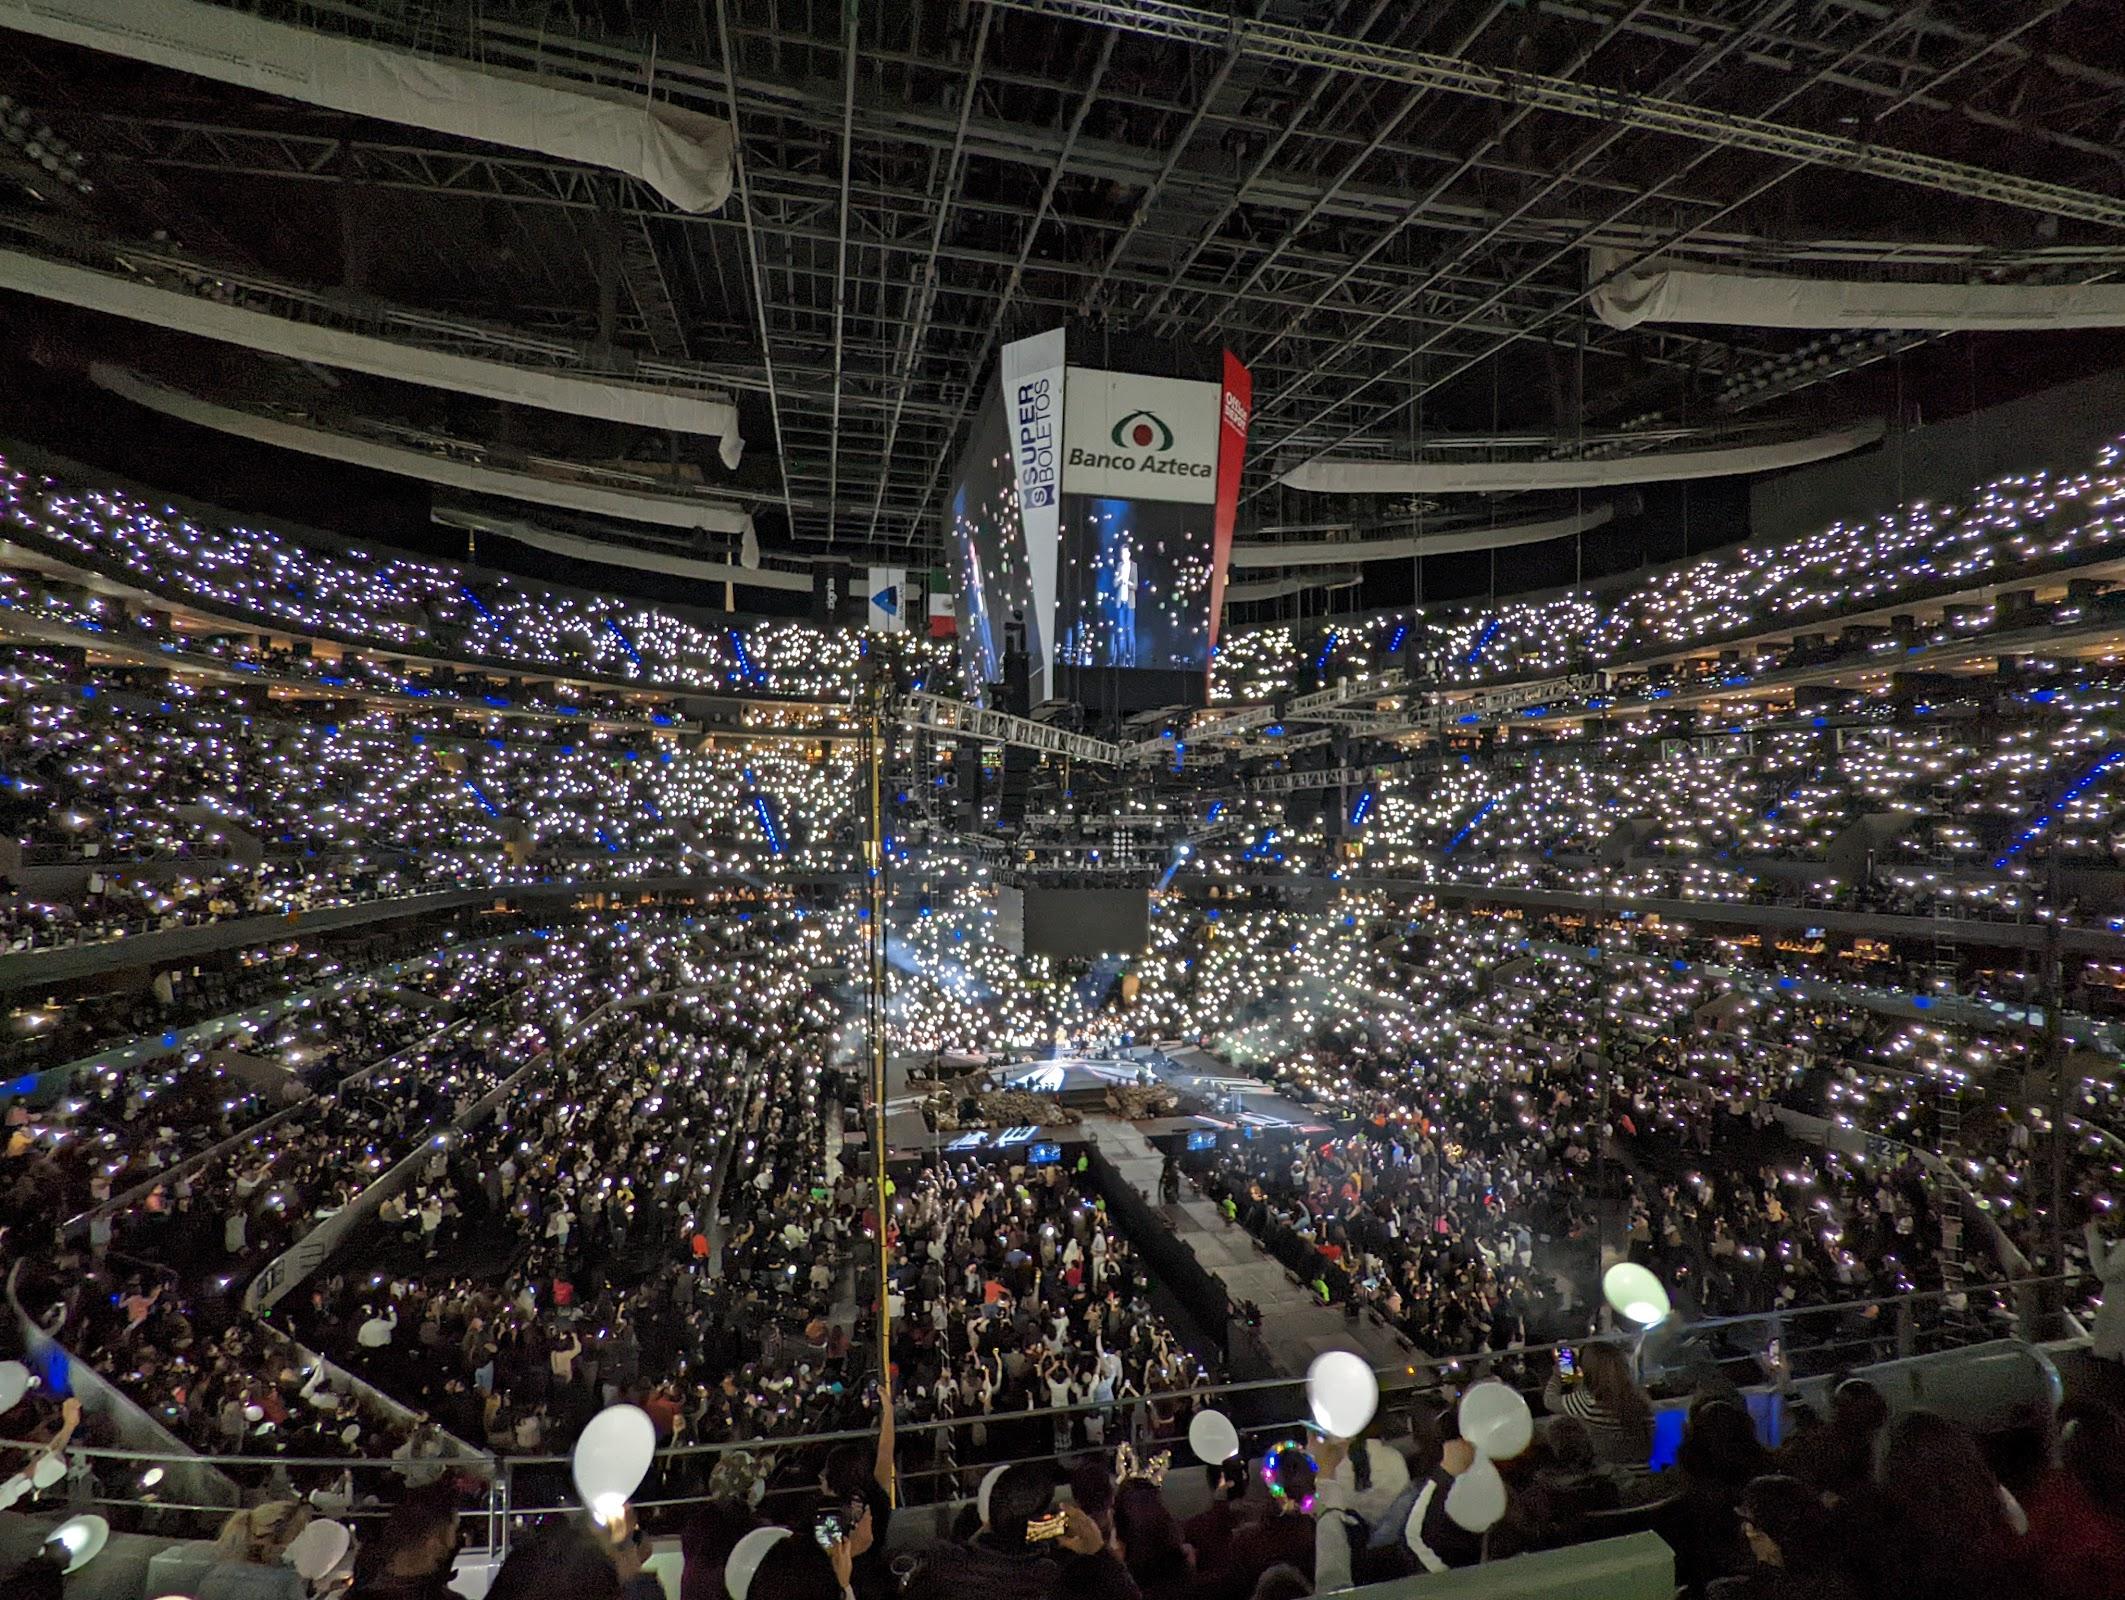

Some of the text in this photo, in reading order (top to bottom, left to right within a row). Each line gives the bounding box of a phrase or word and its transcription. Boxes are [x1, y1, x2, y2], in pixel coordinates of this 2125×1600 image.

[1018, 383, 1038, 485] SUPER
[1034, 379, 1054, 483] BOLETOS
[1069, 448, 1212, 478] Banco Azteca
